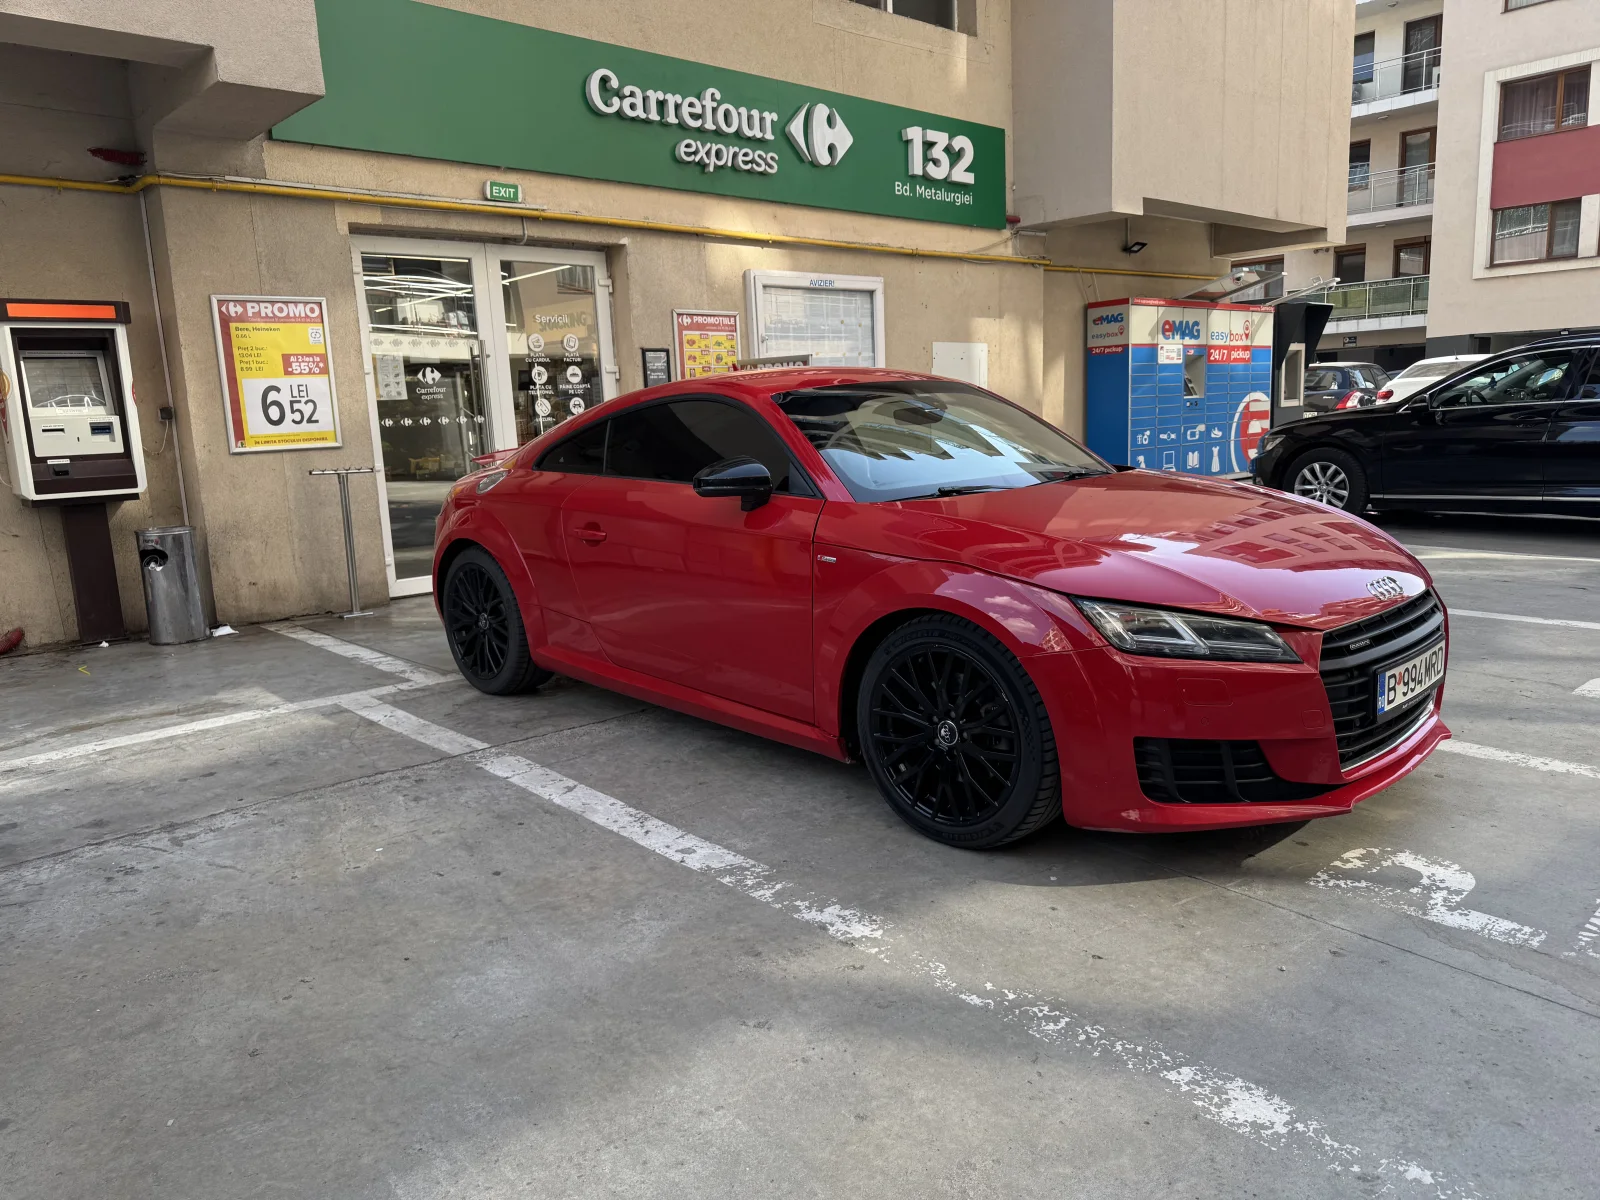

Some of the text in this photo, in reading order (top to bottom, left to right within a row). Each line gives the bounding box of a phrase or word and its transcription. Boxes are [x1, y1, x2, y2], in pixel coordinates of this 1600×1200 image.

[586, 68, 778, 141] Carrefour
[675, 138, 778, 174] express
[901, 126, 974, 184] 132
[492, 186, 516, 198] EXIT
[895, 181, 973, 206] Bd. Metalurgiei
[809, 279, 835, 287] AVIZIER!
[246, 302, 320, 318] PROMO
[535, 314, 568, 323] Servicii
[1092, 313, 1124, 326] eMAG
[1091, 332, 1118, 340] easybox
[1162, 319, 1200, 341] eMAG
[1104, 346, 1123, 354] pickup
[1209, 348, 1250, 361] 24/7 pickup
[290, 384, 309, 398] LEI
[261, 385, 286, 426] 6
[289, 399, 320, 425] 52
[1387, 672, 1397, 706] B
[1402, 659, 1424, 697] 994
[1423, 646, 1444, 685] MRD
